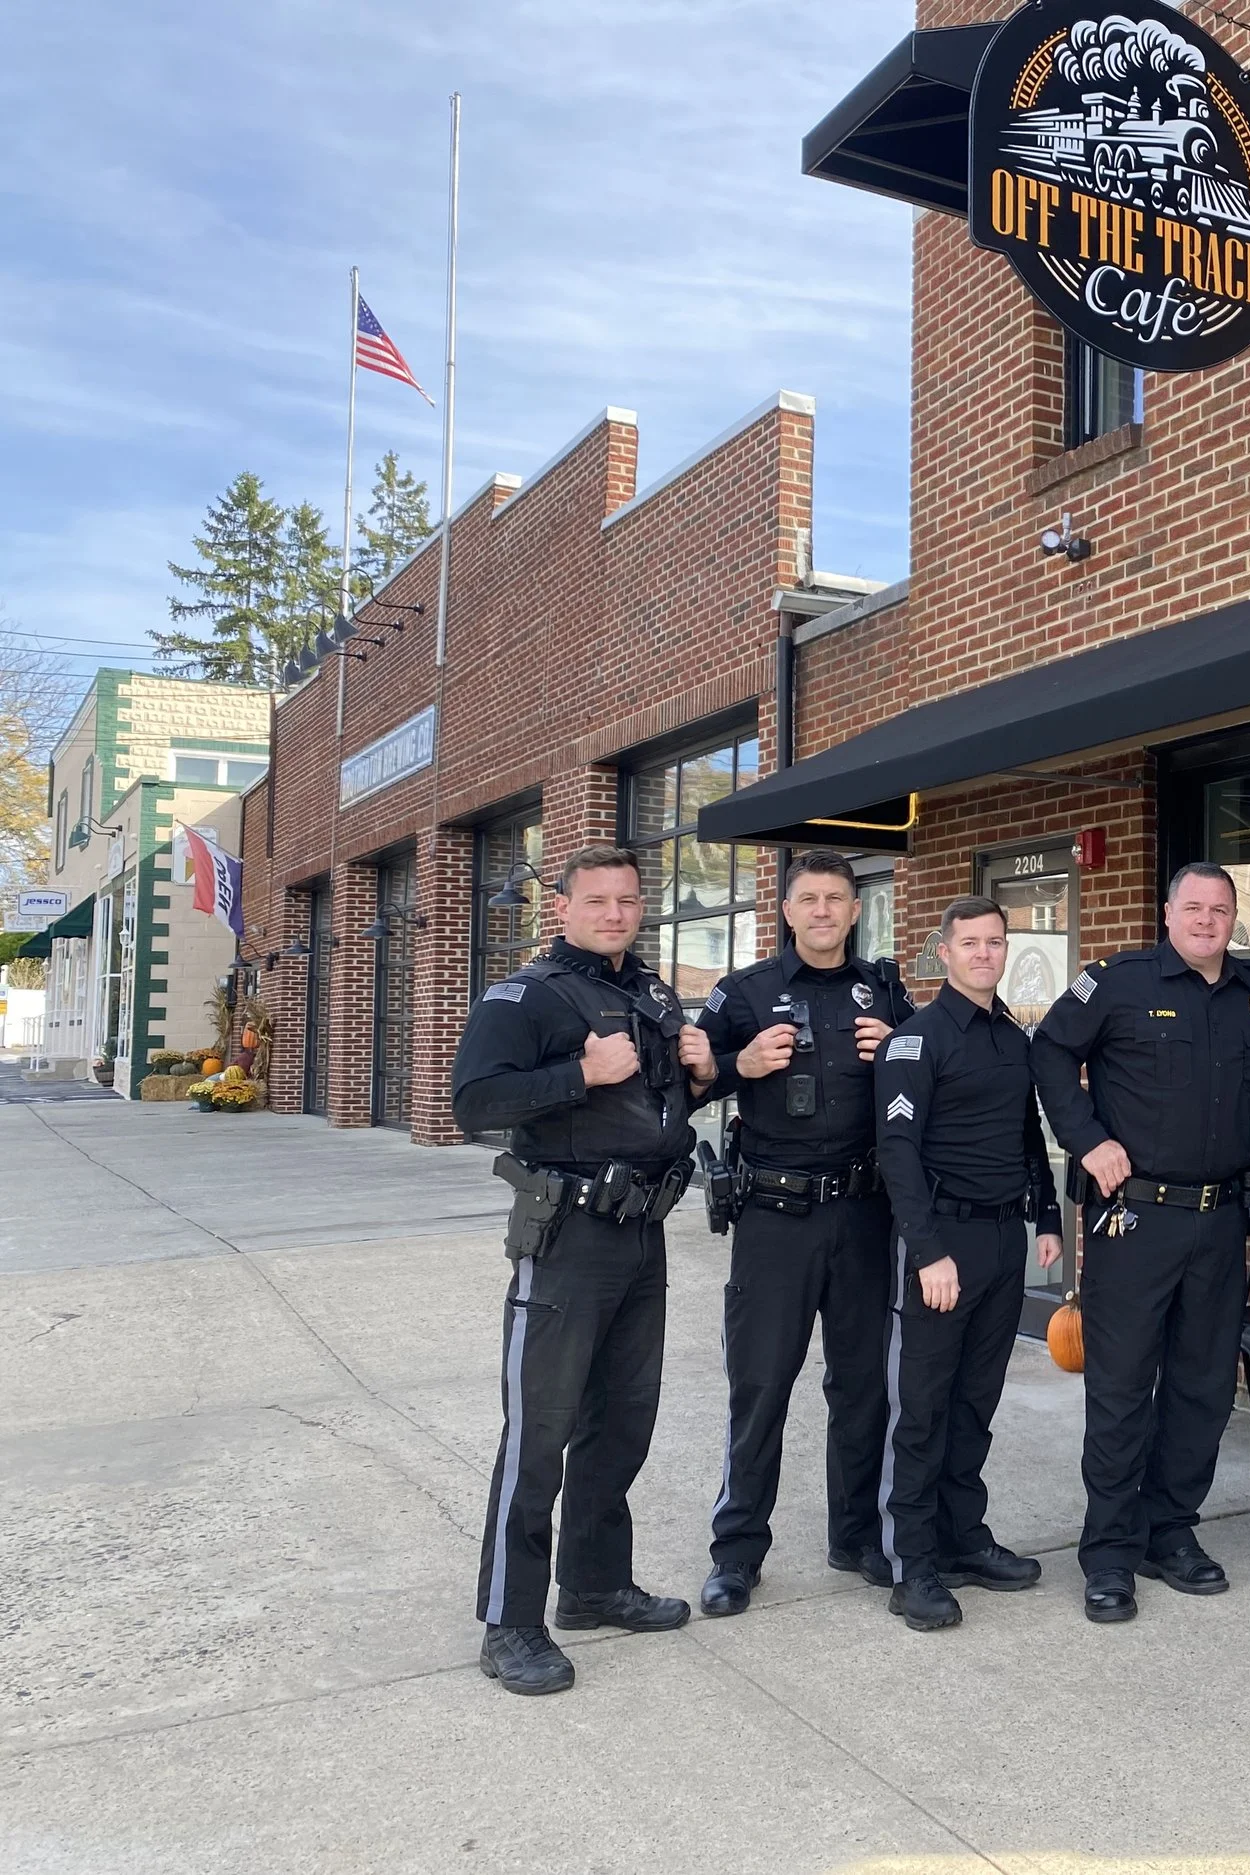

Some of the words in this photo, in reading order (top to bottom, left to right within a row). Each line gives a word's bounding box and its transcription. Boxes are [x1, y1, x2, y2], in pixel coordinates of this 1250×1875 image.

[991, 169, 1060, 248] OFF
[1072, 191, 1144, 275] THE
[214, 855, 232, 917] OPEN
[1014, 854, 1044, 875] 2204
